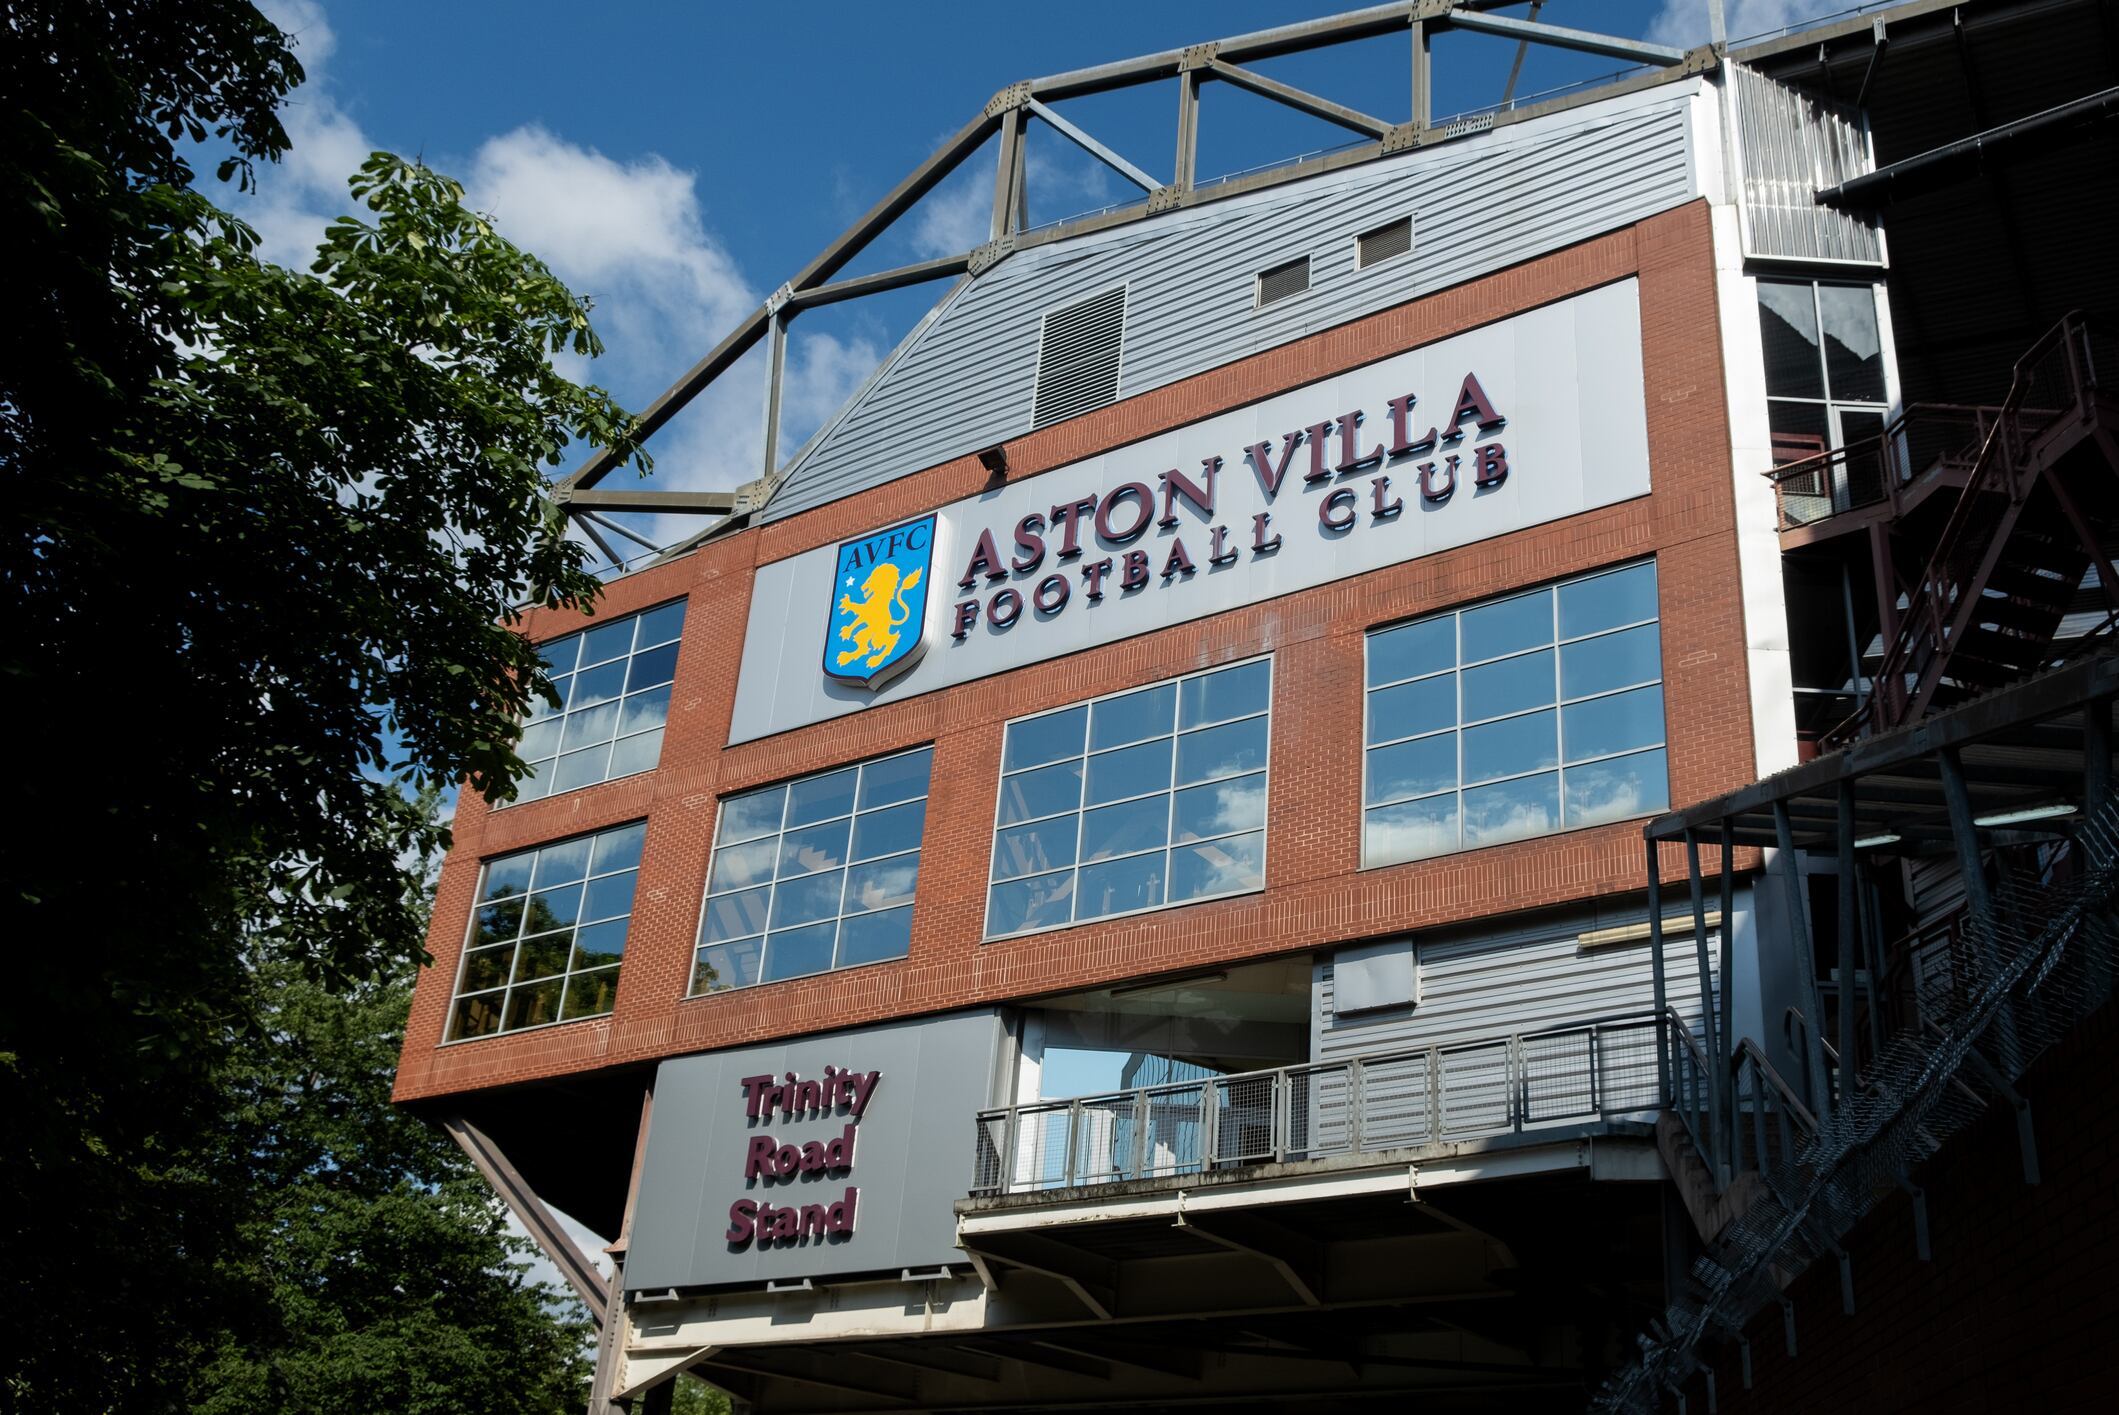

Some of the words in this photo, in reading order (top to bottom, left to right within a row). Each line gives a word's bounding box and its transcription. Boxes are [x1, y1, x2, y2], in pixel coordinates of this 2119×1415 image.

[958, 455, 1222, 588] ASTON
[1244, 371, 1507, 496] VILLA
[843, 525, 927, 573] AVFC
[951, 511, 1282, 640] FOOTBALL
[1318, 442, 1510, 531] CLUB
[741, 1065, 882, 1117] Trinity
[745, 1124, 858, 1179] Road
[726, 1187, 860, 1243] Stand
